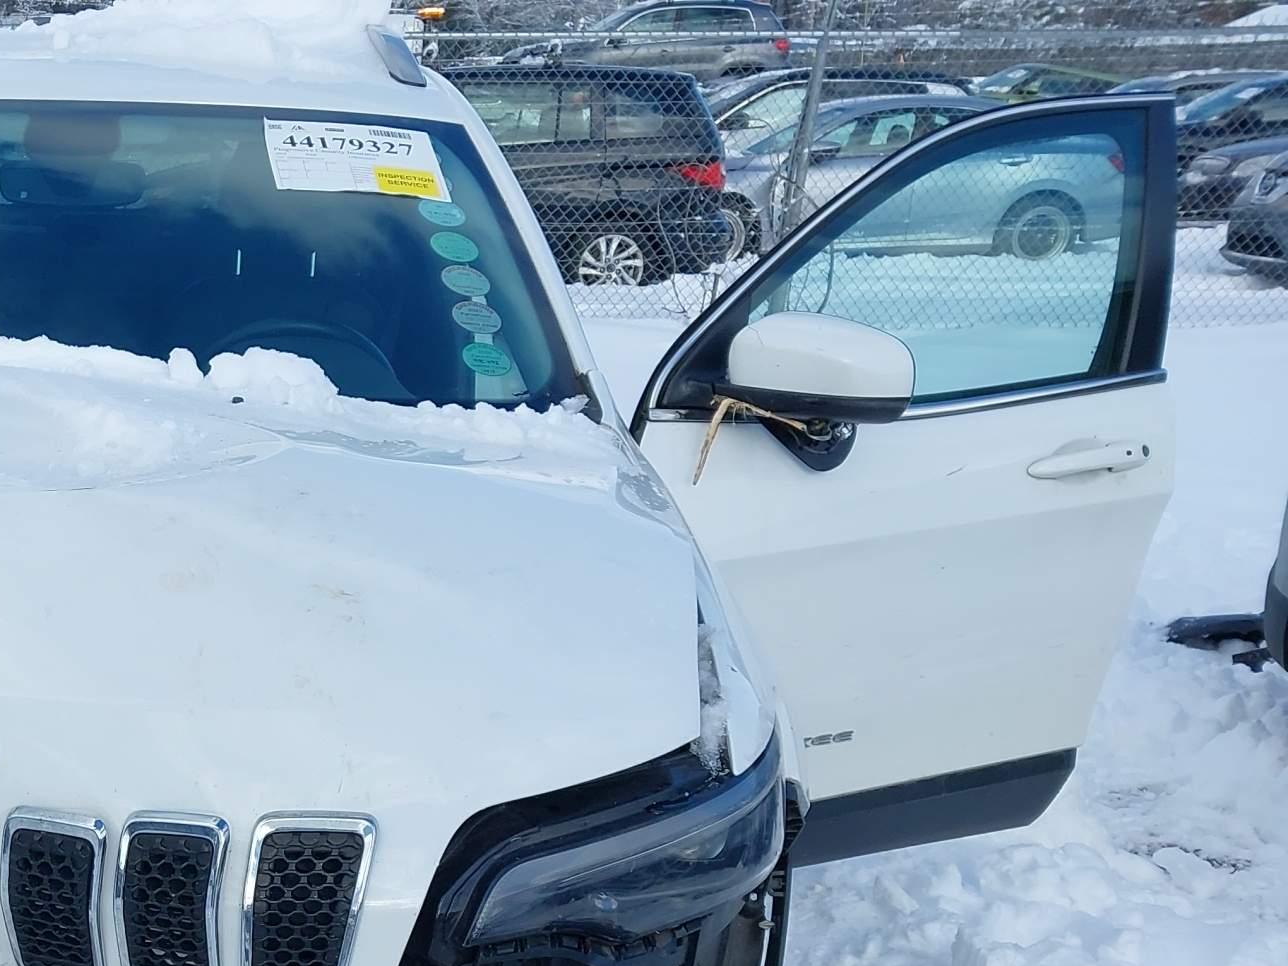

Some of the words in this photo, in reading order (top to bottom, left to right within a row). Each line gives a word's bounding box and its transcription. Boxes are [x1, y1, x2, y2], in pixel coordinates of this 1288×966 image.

[282, 135, 414, 156] 44179327
[377, 172, 436, 184] INSPECTION
[386, 179, 430, 189] SERVICE
